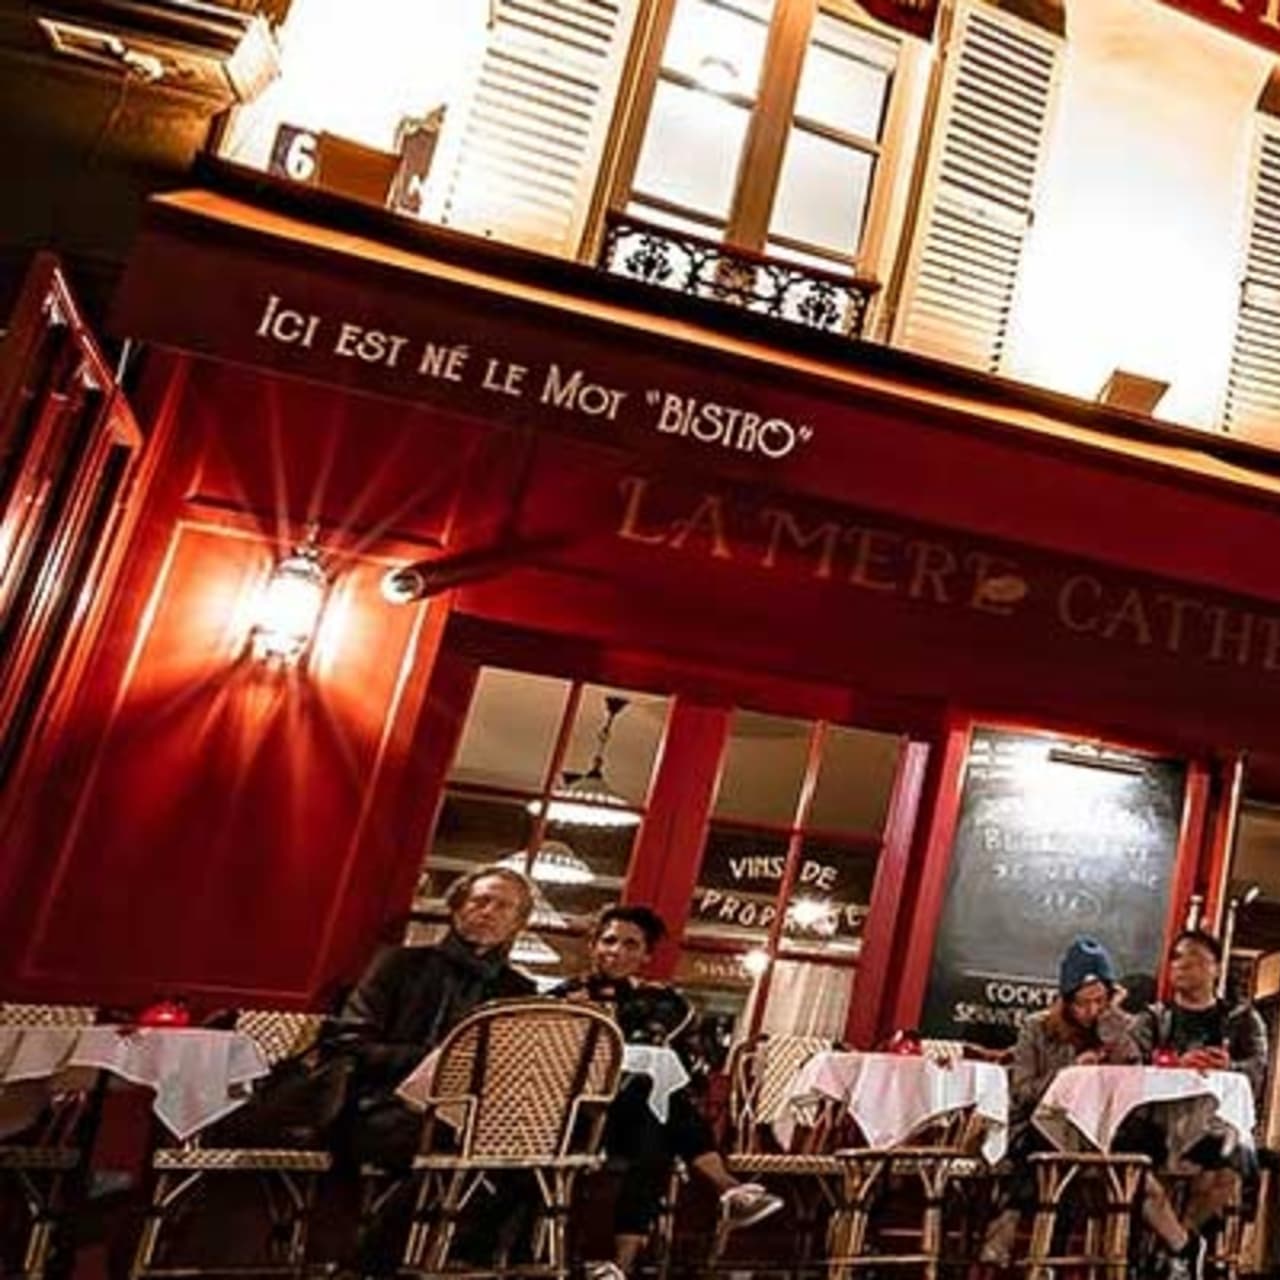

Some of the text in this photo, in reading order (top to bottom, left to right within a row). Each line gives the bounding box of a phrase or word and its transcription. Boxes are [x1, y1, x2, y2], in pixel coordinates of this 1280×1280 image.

[334, 323, 409, 367] EST
[418, 343, 470, 382] NÉ
[482, 358, 528, 397] LE
[617, 476, 732, 559] LA
[729, 856, 838, 890] VINS DE
[986, 982, 1060, 1006] COCKT
